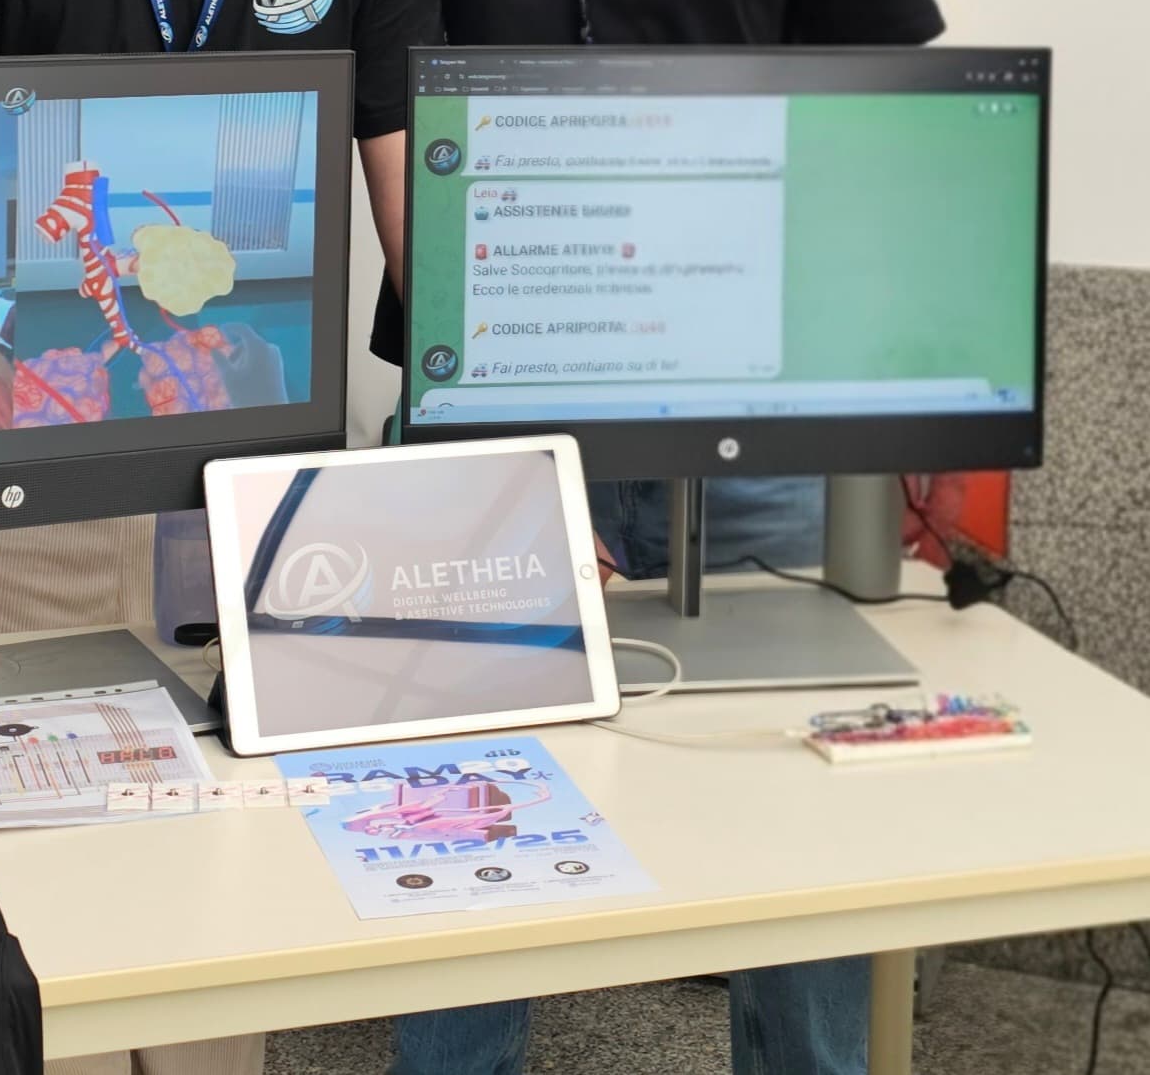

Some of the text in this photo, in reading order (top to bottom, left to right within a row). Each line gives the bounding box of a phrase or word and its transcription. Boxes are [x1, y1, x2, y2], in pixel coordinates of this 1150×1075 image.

[495, 115, 546, 128] CODICE
[495, 155, 515, 167] Fai
[517, 155, 561, 169] presto,
[493, 205, 578, 219] ASSISTENTE
[493, 244, 558, 257] ALLARME
[473, 264, 508, 277] Salve
[472, 284, 505, 297] Ecco
[507, 284, 519, 296] le
[492, 323, 543, 336] CODICE
[492, 362, 512, 374] Fai
[514, 362, 559, 376] presto,
[562, 360, 623, 373] contiamo
[391, 553, 547, 591] ALETHEIA
[393, 588, 507, 608] DIGITAL WELLBEING
[407, 606, 464, 620] ASSISTIVE
[468, 597, 550, 613] TECHNOLOGIES
[326, 763, 462, 785] RAM
[405, 766, 533, 789] DAY
[354, 829, 590, 862] 11/12/25
